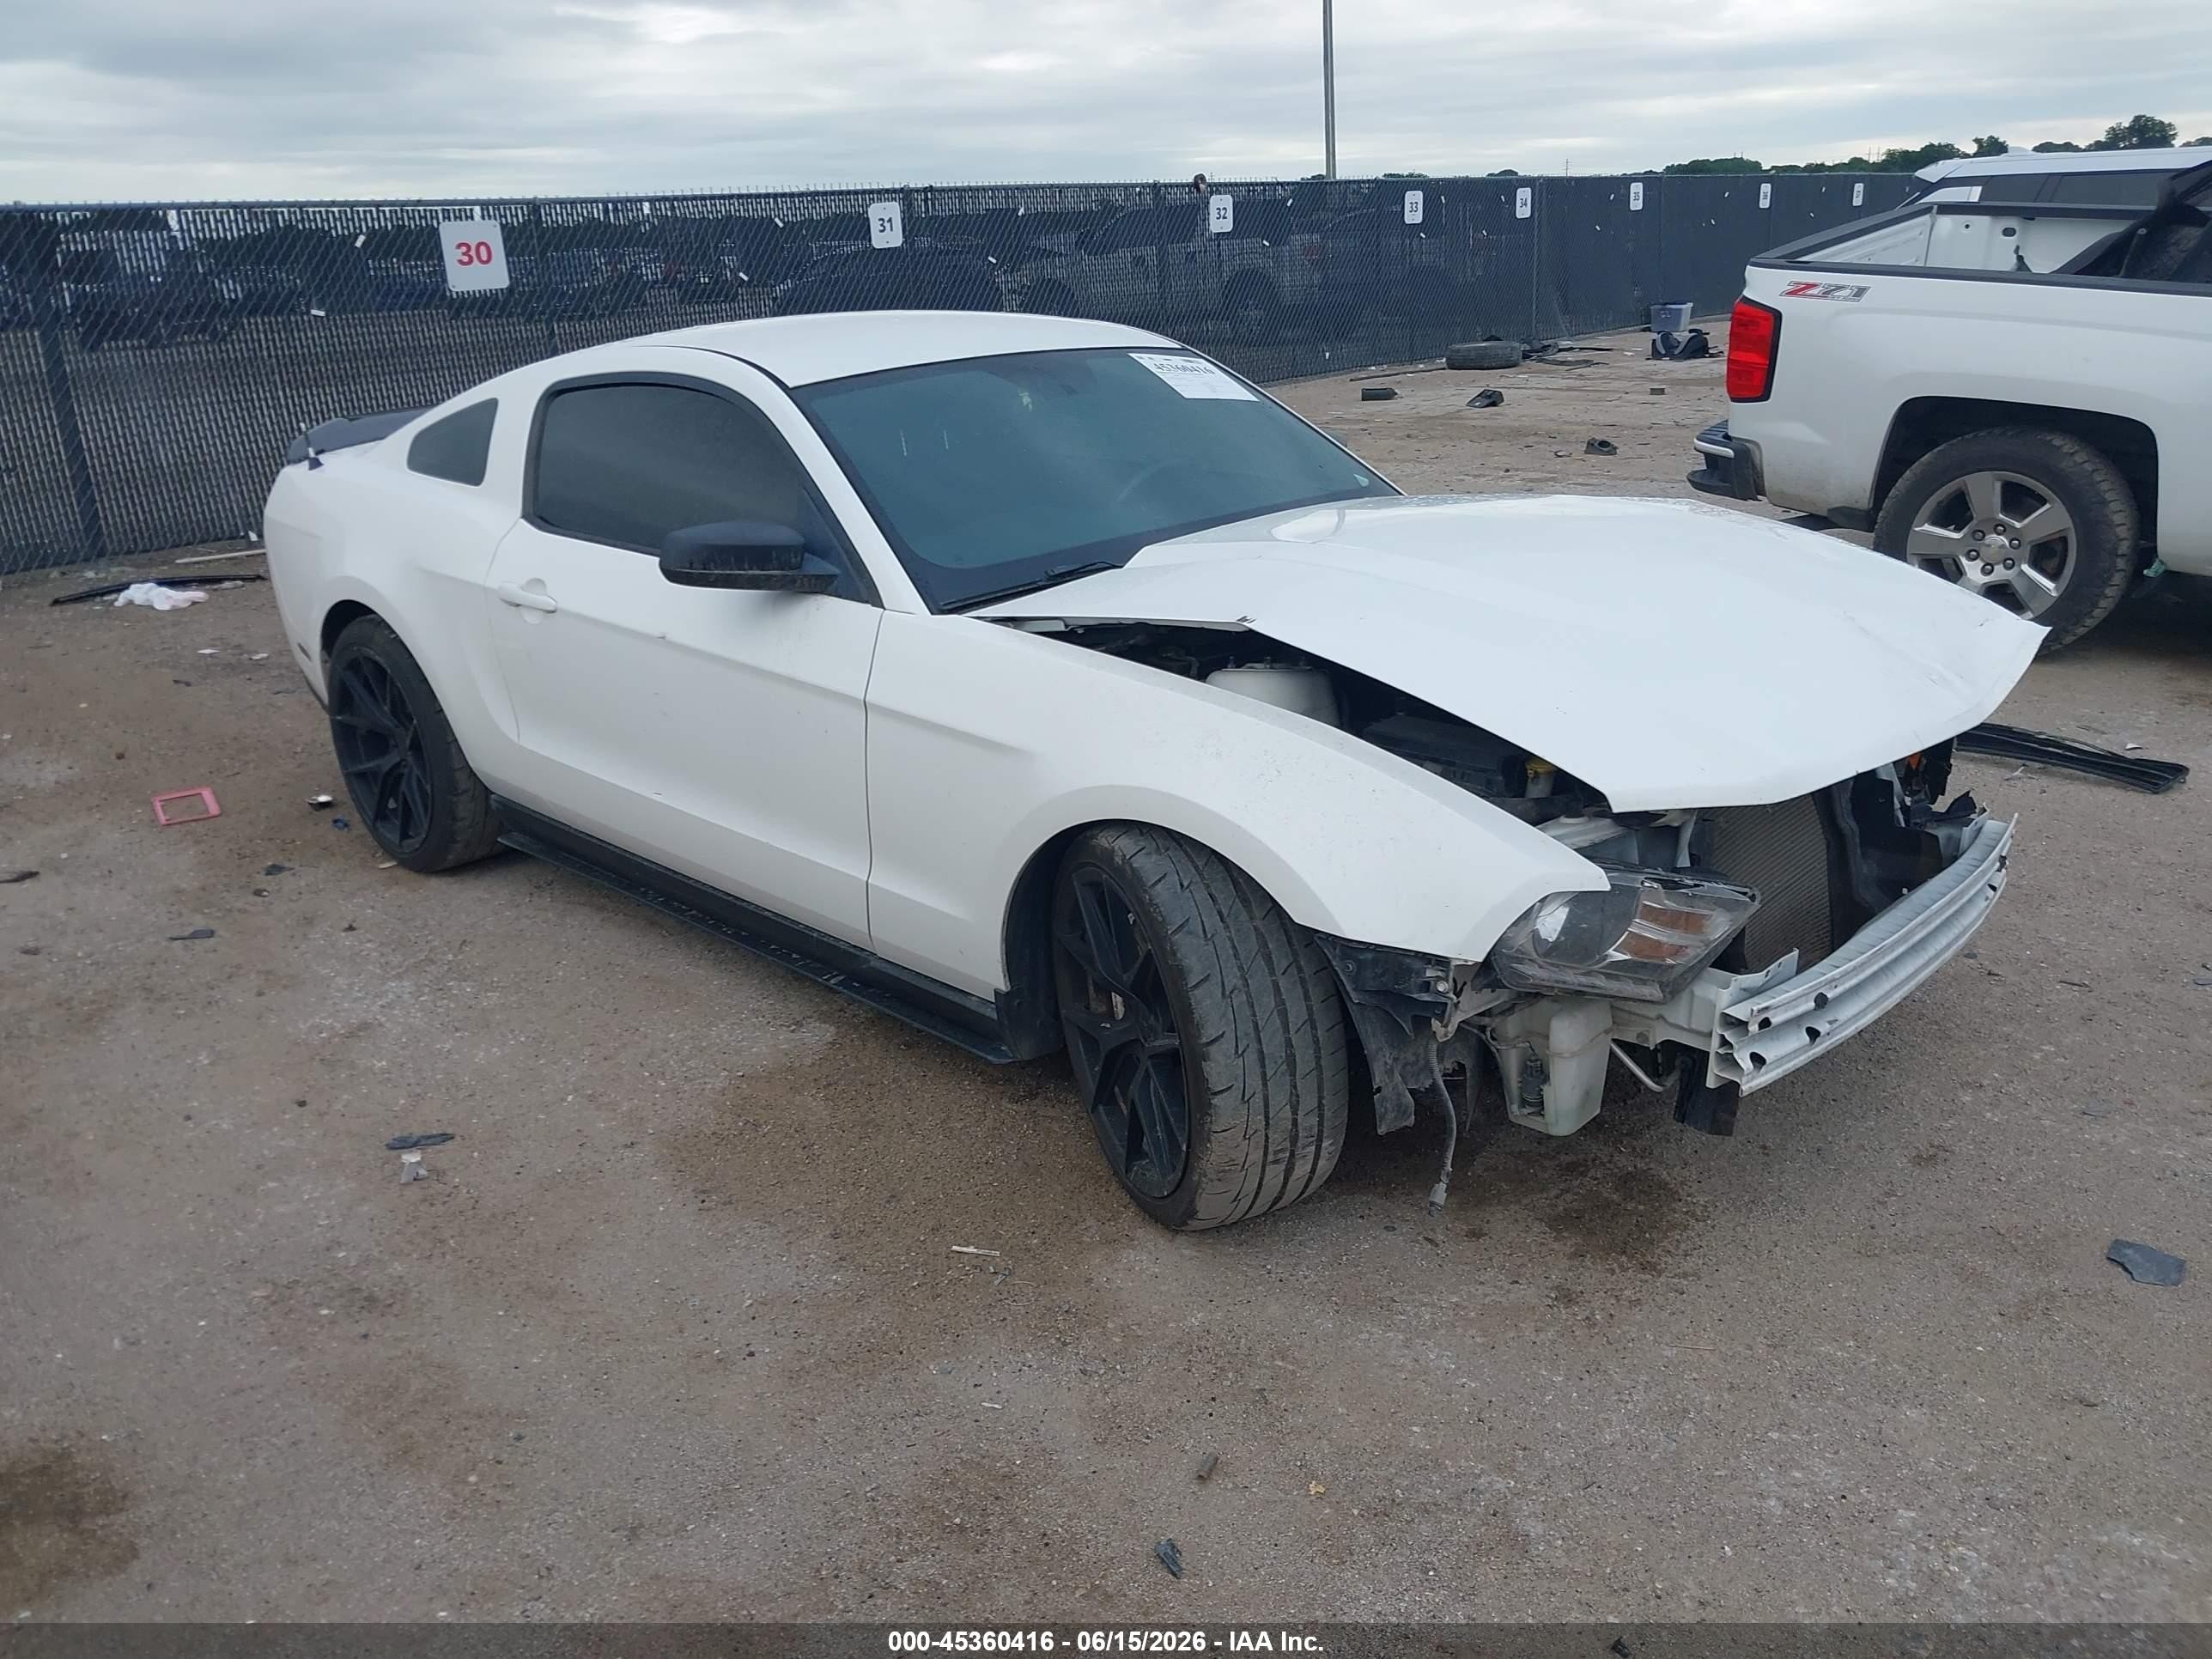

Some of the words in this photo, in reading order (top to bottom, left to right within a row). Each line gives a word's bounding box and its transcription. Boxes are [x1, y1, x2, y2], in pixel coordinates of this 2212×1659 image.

[1408, 201, 1419, 213] 33
[1519, 198, 1528, 208] 34
[1215, 207, 1228, 221] 32
[878, 216, 894, 234] 31
[454, 240, 493, 267] 30
[1778, 281, 1872, 303] Z71
